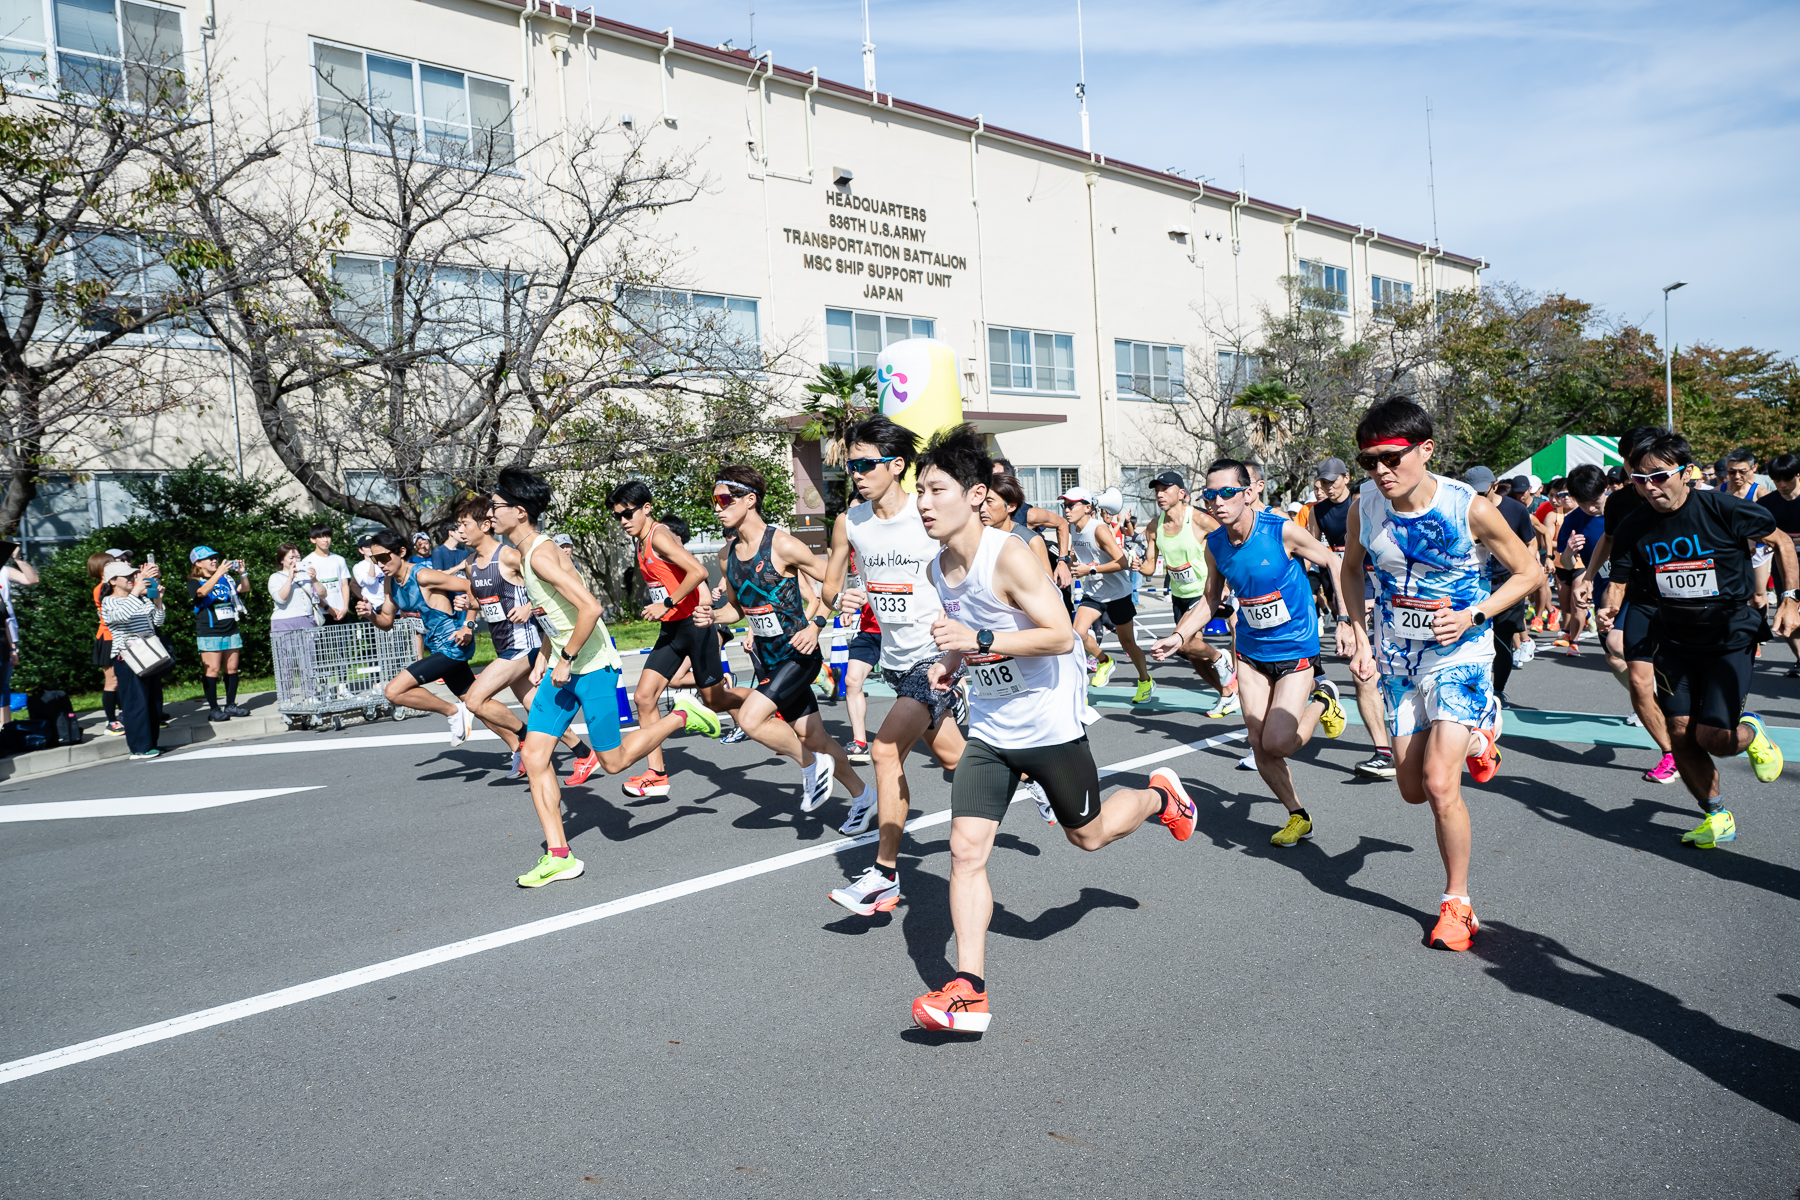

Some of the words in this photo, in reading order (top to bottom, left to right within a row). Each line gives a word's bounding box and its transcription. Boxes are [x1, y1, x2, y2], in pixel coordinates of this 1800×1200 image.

[826, 190, 927, 222] HEADQUARTERS
[829, 213, 866, 233] 836TH
[783, 228, 900, 260] TRANSPORTATION
[904, 247, 967, 270] BATTALION
[803, 253, 832, 271] MSC
[836, 259, 864, 275] SHIP
[868, 263, 923, 284] SUPPORT
[927, 272, 952, 288] UNIT
[863, 284, 903, 302] JAPAN
[1645, 534, 1714, 566] IDOL
[861, 553, 886, 567] Keith
[1665, 573, 1707, 589] 1007
[873, 596, 907, 613] 1333
[1247, 604, 1278, 621] 1687
[750, 616, 774, 629] 1873
[974, 665, 1013, 687] 1818
